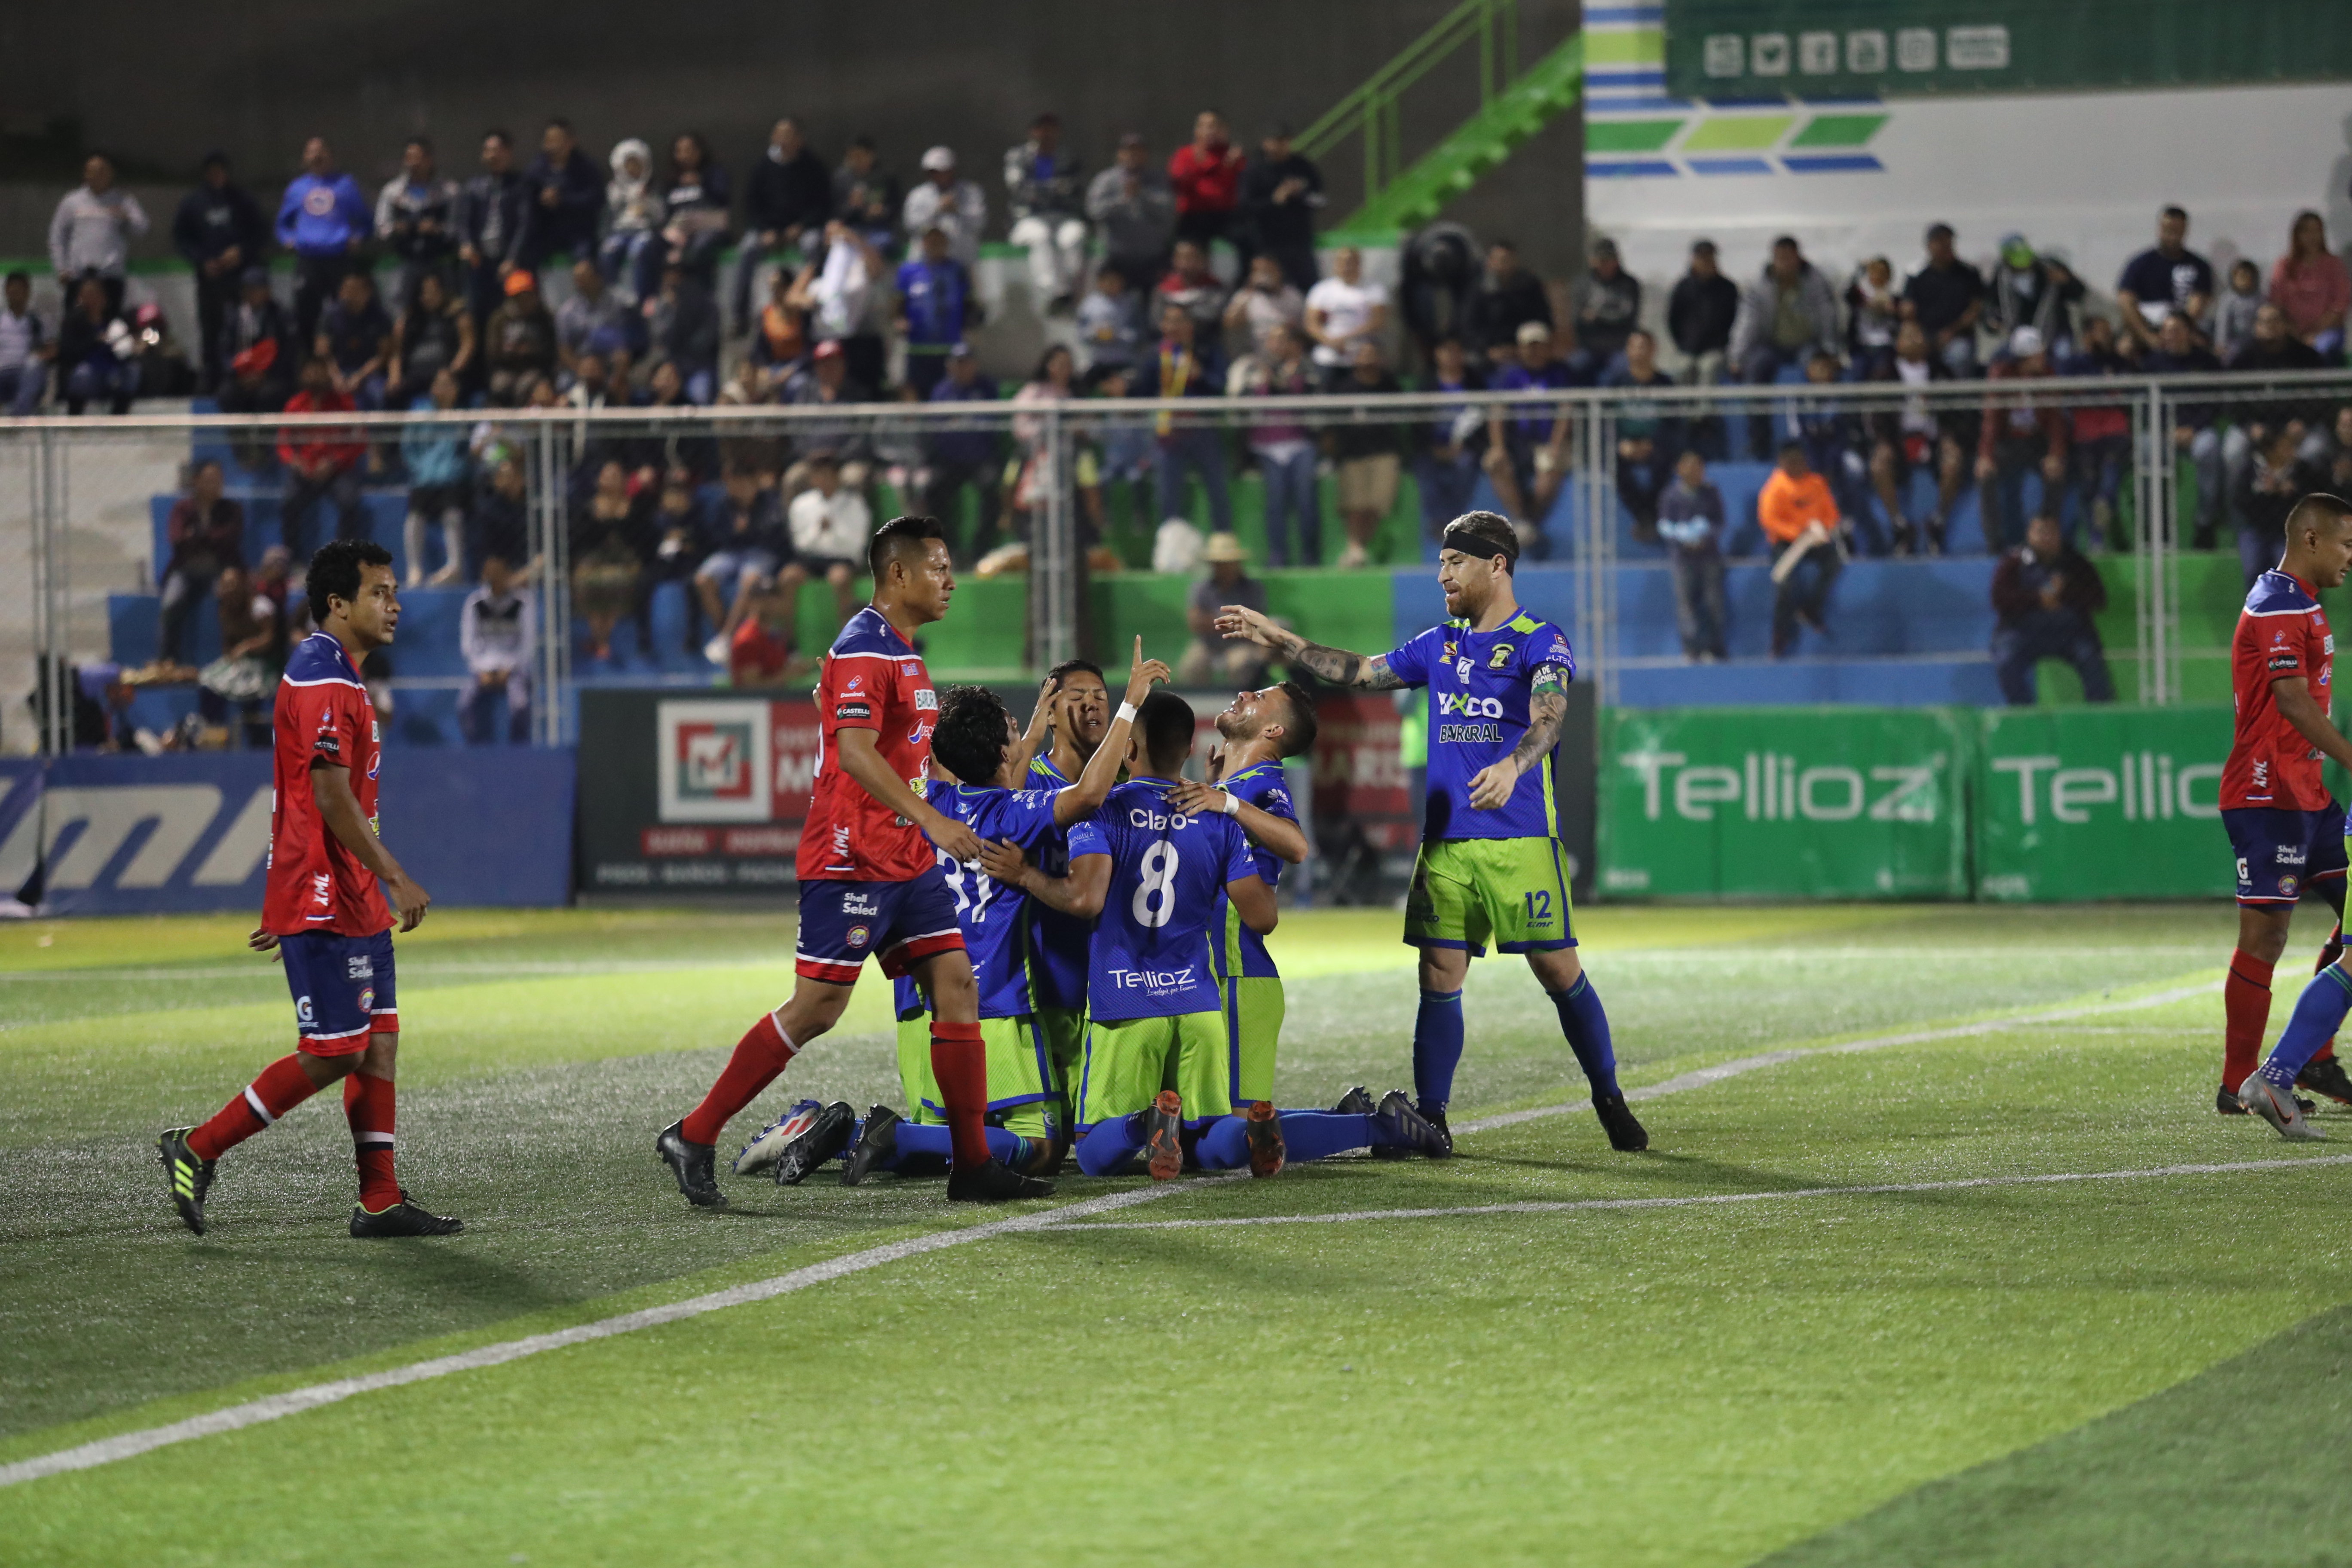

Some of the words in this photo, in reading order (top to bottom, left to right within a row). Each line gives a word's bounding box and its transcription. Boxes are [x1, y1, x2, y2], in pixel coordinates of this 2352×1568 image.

[1619, 752, 1936, 822] Tellioz
[1993, 753, 2226, 824] Tellio
[833, 823, 849, 858] XMC
[1072, 832, 1094, 842] ANALIZA
[312, 870, 329, 906] XMC
[844, 892, 867, 903] Shell
[1132, 839, 1179, 928] 8
[842, 902, 877, 916] Select
[1525, 890, 1552, 919] 12
